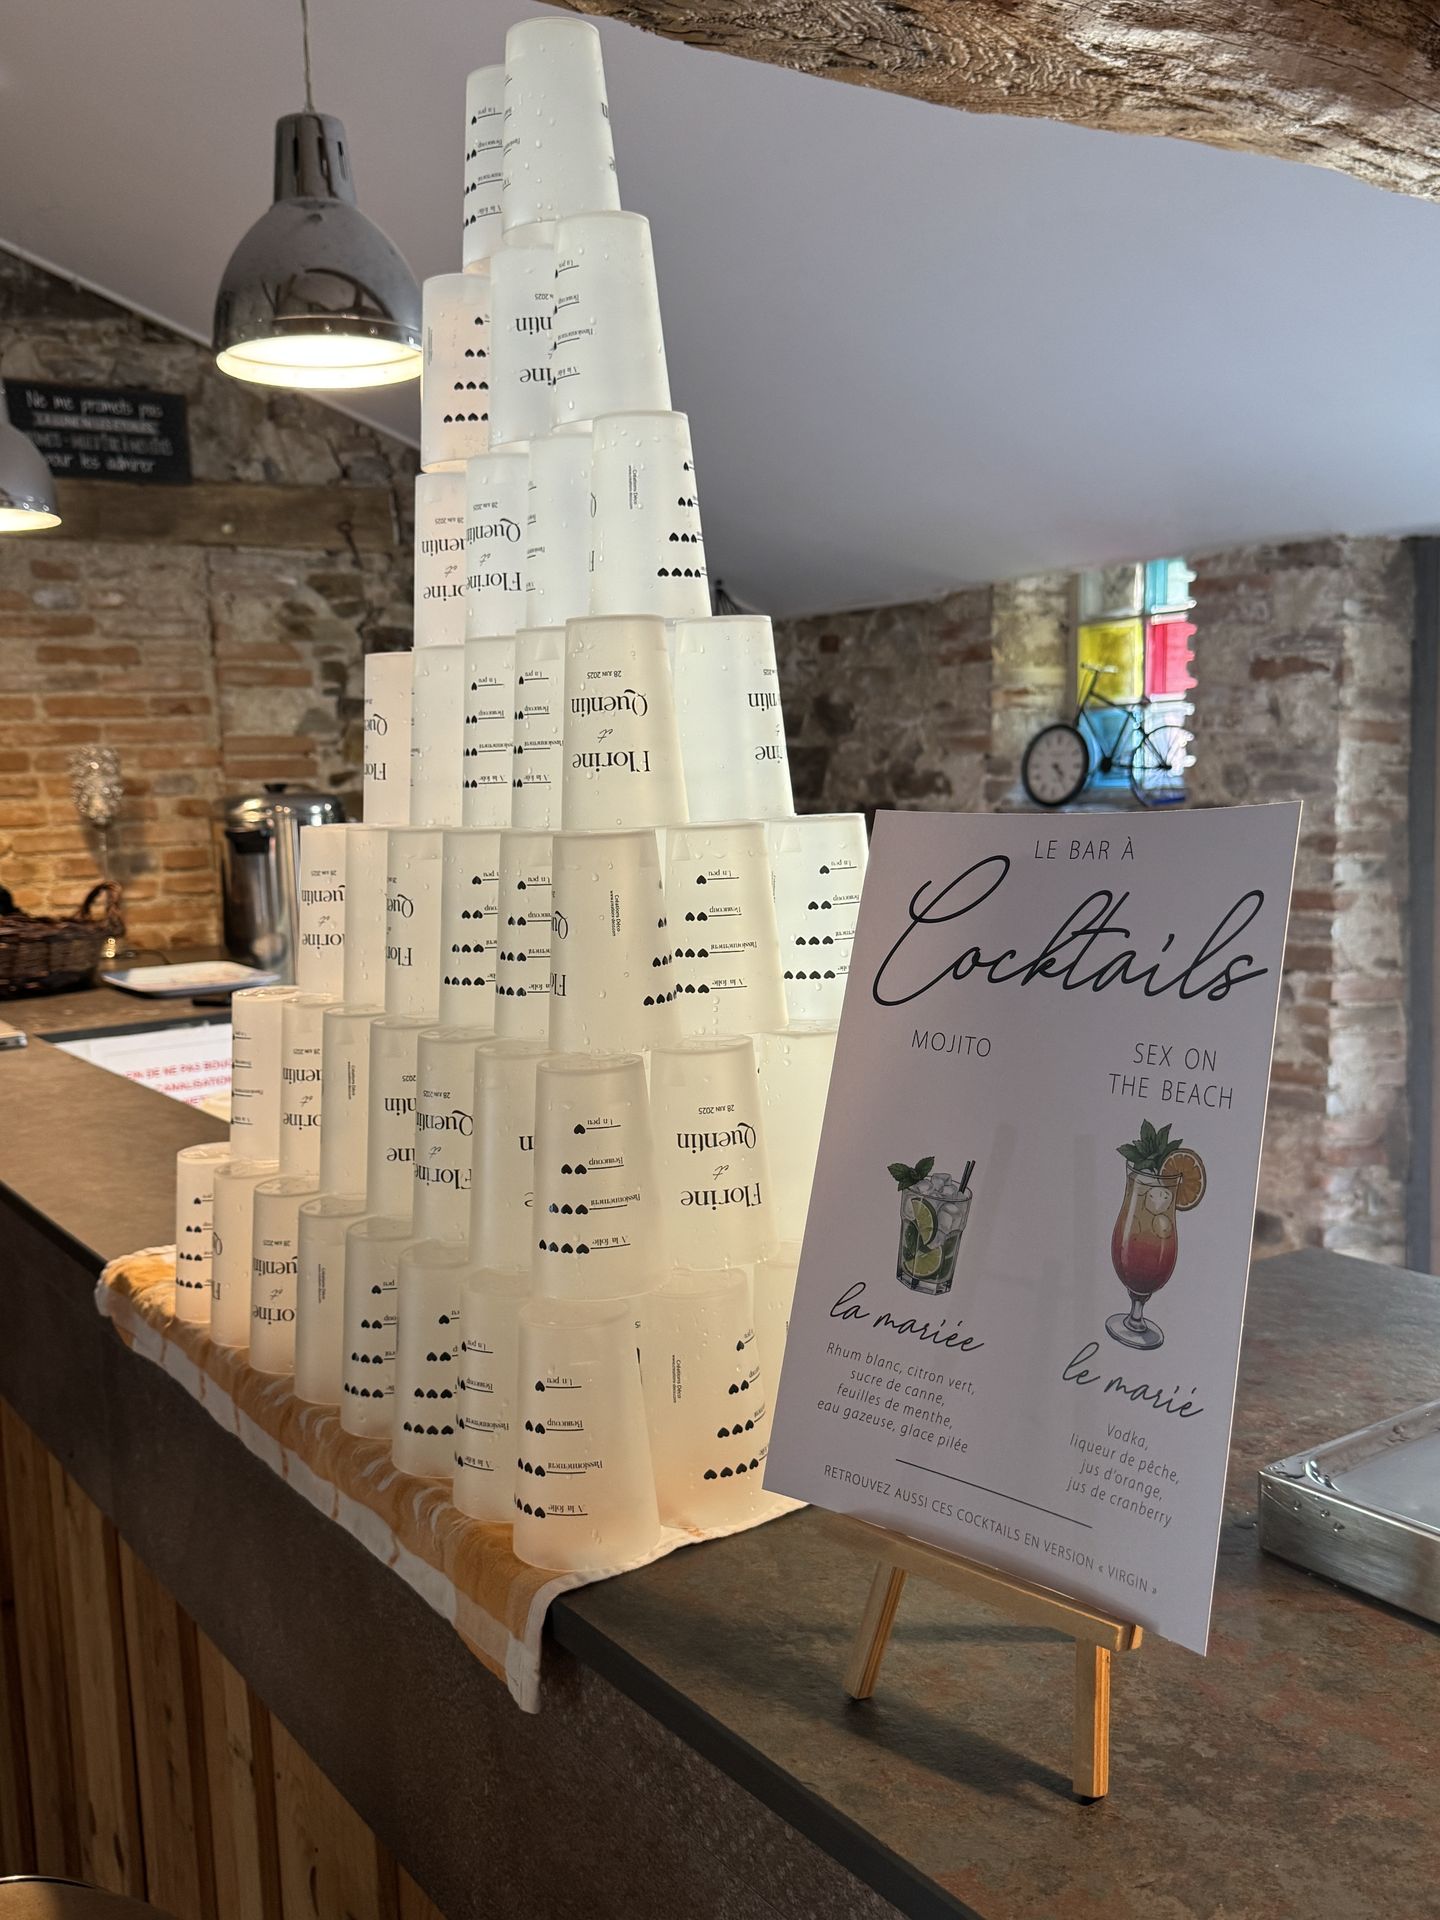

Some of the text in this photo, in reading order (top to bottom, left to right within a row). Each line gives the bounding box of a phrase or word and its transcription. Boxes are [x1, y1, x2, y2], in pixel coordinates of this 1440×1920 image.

[516, 317, 552, 335] ntin
[572, 689, 647, 717] Quentin
[748, 693, 776, 711] ntin
[597, 729, 613, 743] et
[573, 751, 650, 772] Florine
[1035, 836, 1134, 860] LE BAR À
[302, 885, 345, 906] uentin
[303, 934, 342, 949] orine
[872, 854, 1269, 1006] Cocktails
[912, 1029, 991, 1057] MOJITO
[1133, 1042, 1216, 1072] SEX ON
[1109, 1073, 1232, 1109] THE BEACH
[385, 1098, 416, 1116] ntin
[283, 1113, 319, 1130] orine
[430, 1146, 441, 1157] et
[677, 1122, 756, 1153] Quentin
[713, 1165, 729, 1180] et
[681, 1183, 761, 1210] Florine
[253, 1256, 298, 1276] uentin
[252, 1305, 294, 1325] orine
[830, 1282, 985, 1352] la mariée
[827, 1342, 976, 1396] Rhum blanc, citron vert,
[1063, 1342, 1205, 1418] le marié
[850, 1370, 946, 1407] sucre de canne,
[837, 1383, 953, 1429] feuilles de menthe,
[818, 1400, 969, 1454] eau gazeuse, glace pilée
[1107, 1423, 1149, 1452] Vodka,
[1070, 1433, 1180, 1486] liqueur de pêche,
[1080, 1460, 1100, 1477] jus
[1066, 1477, 1173, 1529] jus de cranberry
[824, 1465, 890, 1496] RETROUVEZ
[894, 1488, 927, 1508] AUSSI
[931, 1499, 952, 1516] CES
[957, 1509, 1020, 1541] COCKTAILS
[1025, 1533, 1040, 1548] EN
[1044, 1540, 1093, 1569] VERSION
[1109, 1564, 1148, 1592] VIRGIN
